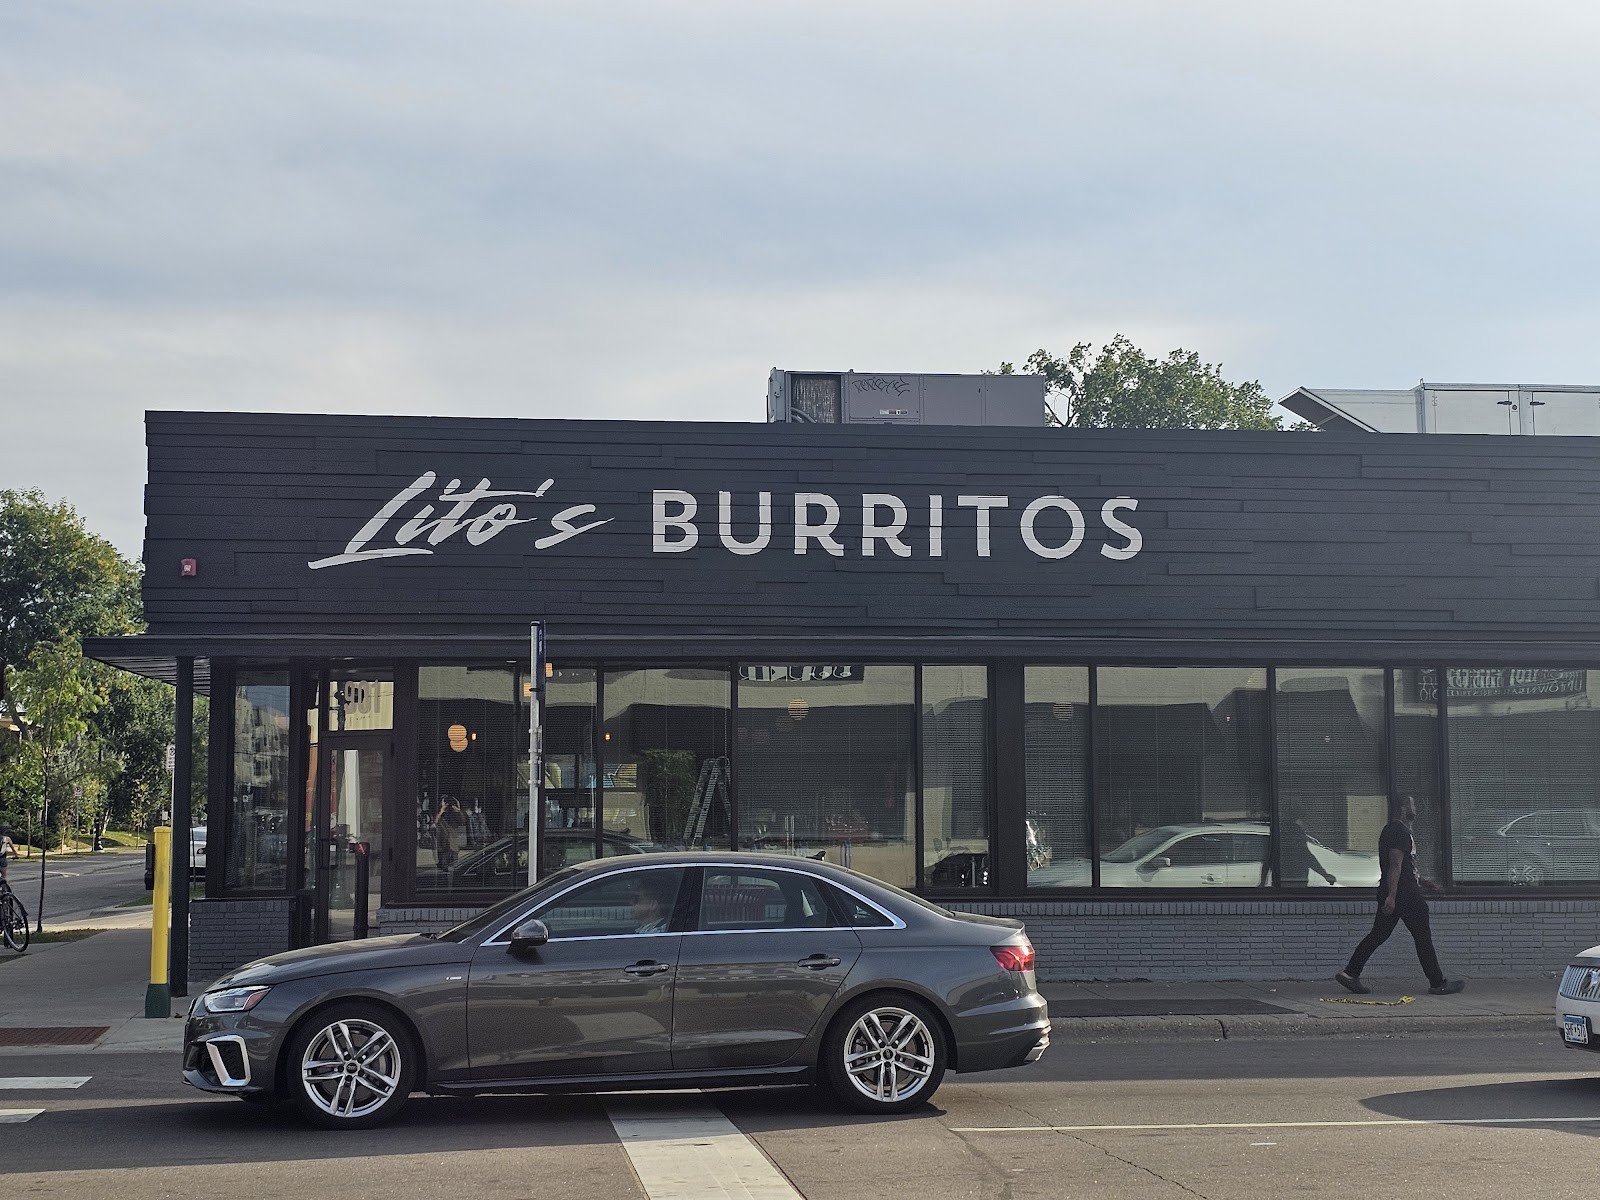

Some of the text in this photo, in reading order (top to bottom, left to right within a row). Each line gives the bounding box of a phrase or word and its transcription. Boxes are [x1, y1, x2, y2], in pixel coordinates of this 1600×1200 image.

[307, 470, 1144, 569] Lito's BURRITOS
[344, 679, 380, 714] 901
